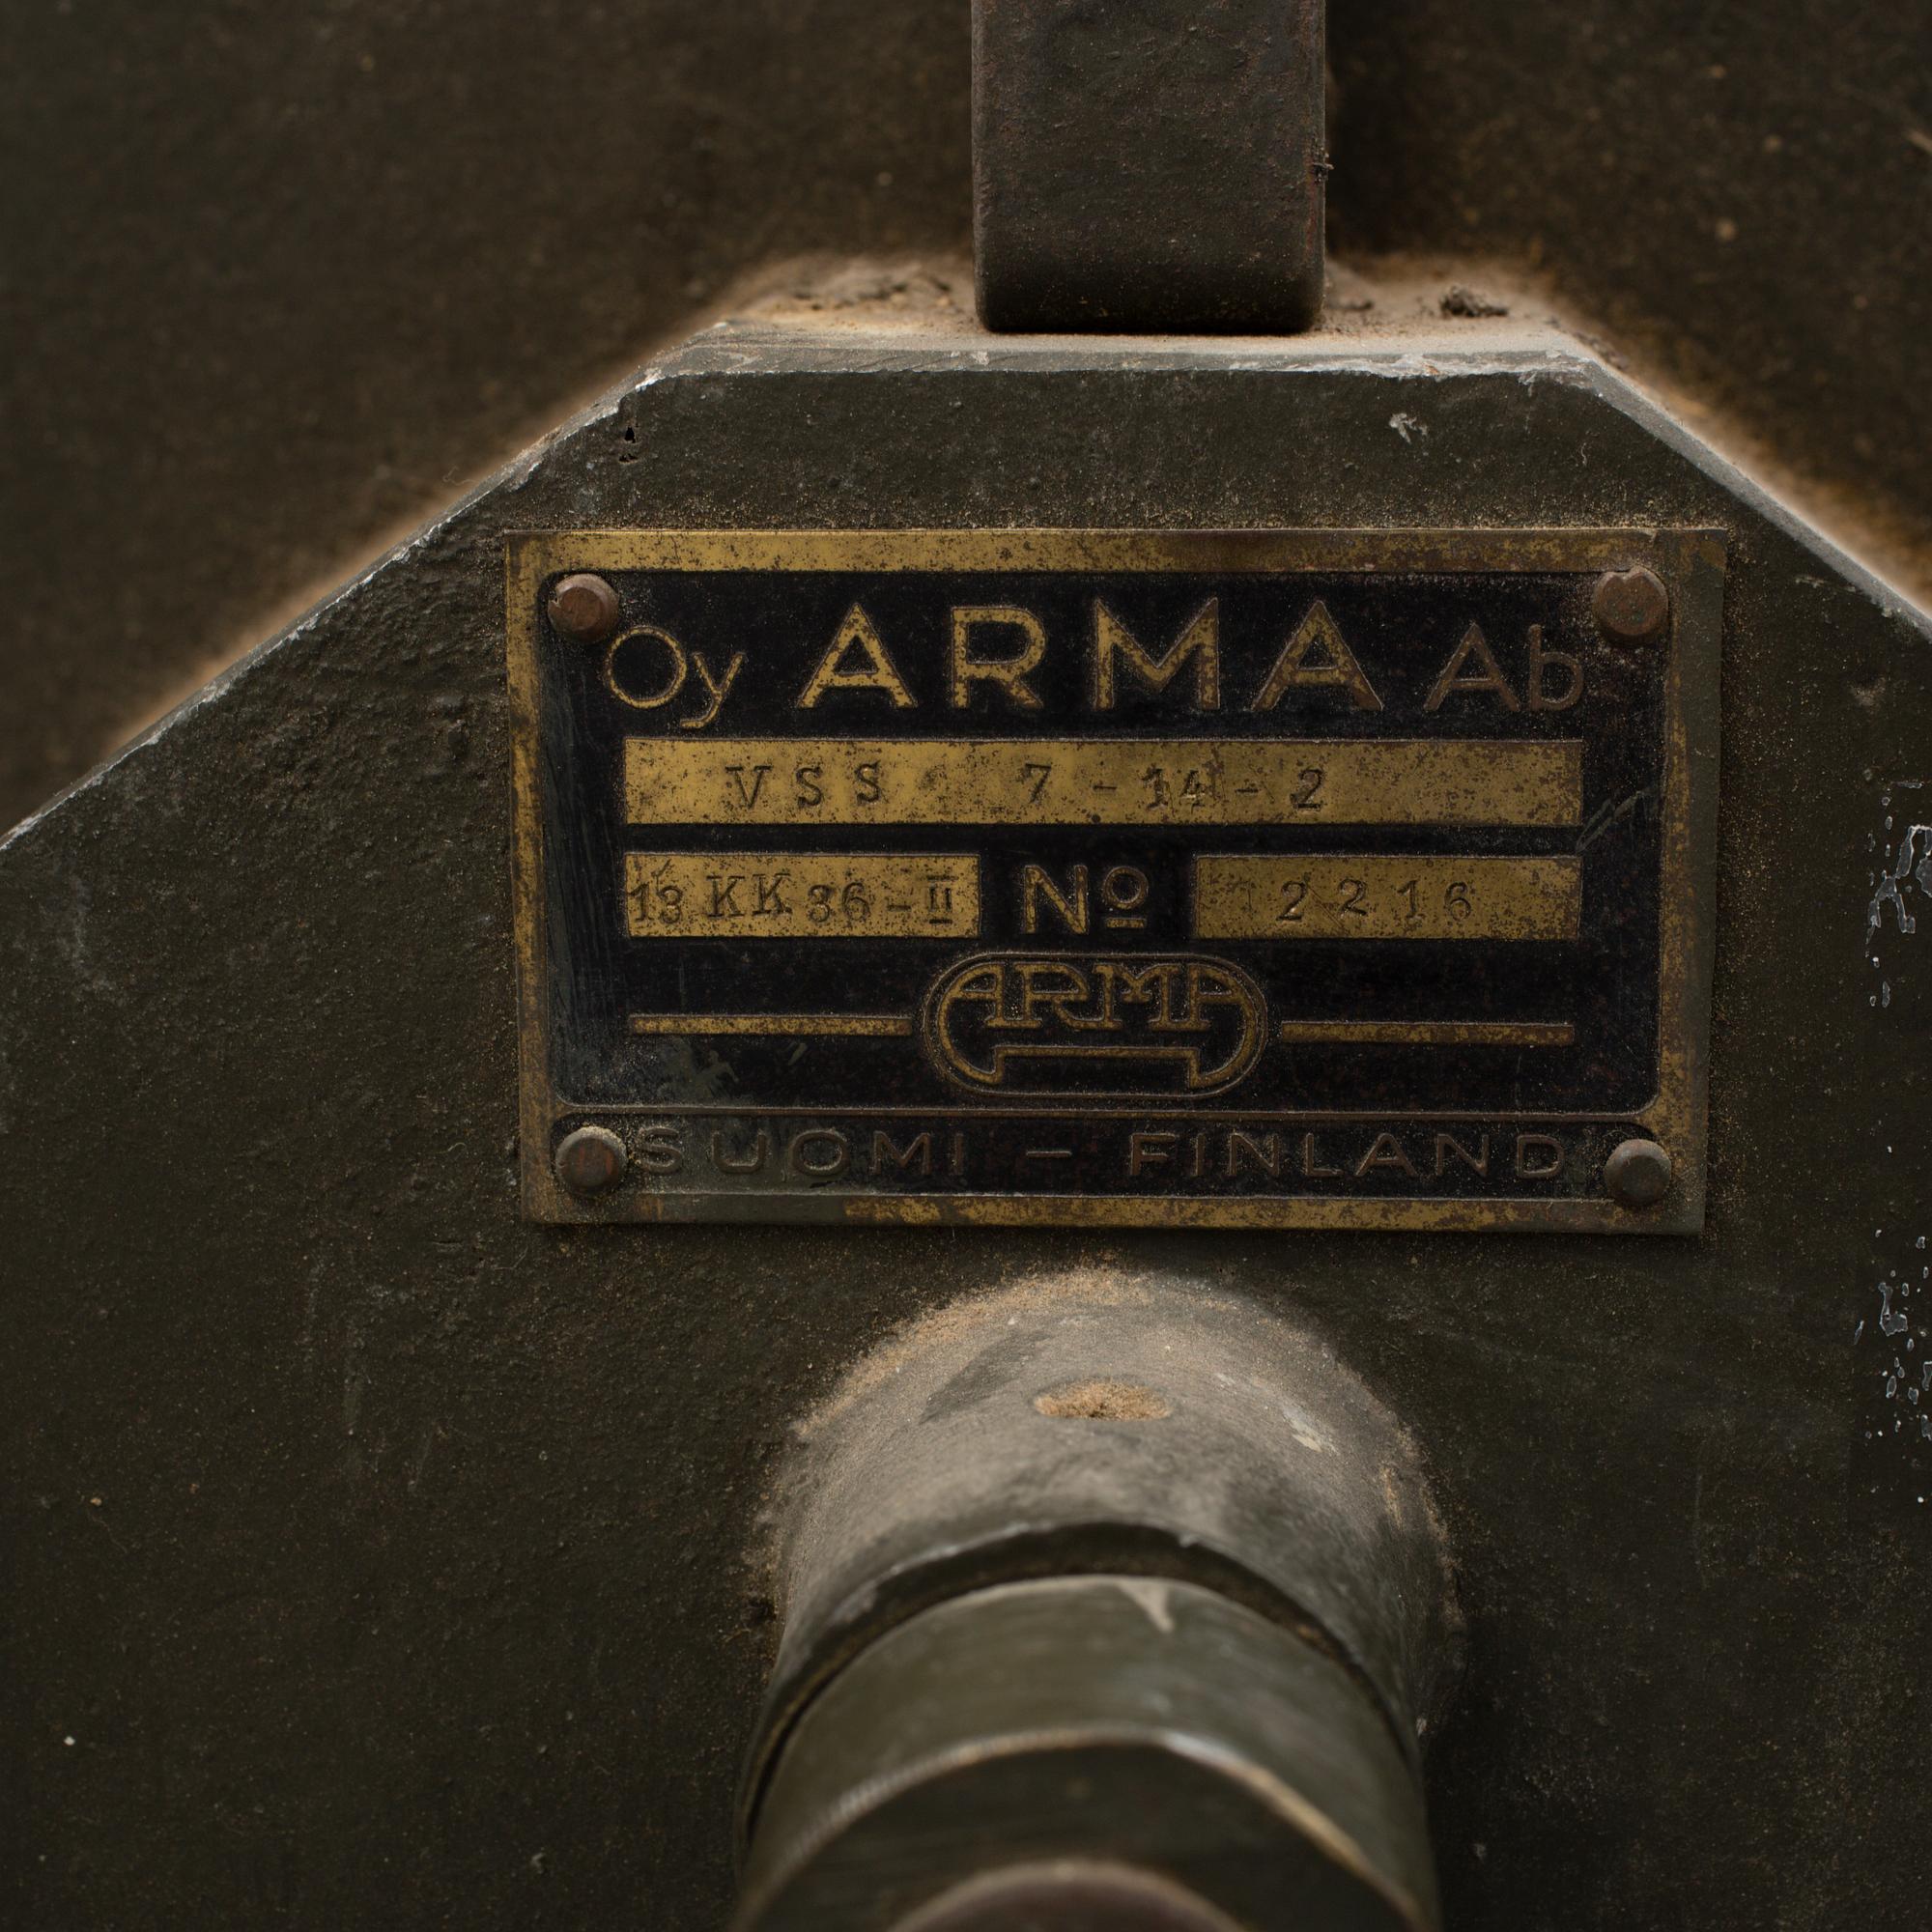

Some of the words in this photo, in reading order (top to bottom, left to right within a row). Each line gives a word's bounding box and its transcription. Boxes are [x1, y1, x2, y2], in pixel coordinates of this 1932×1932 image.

[605, 624, 746, 729] Oy
[796, 596, 1384, 710] ARMA
[1422, 621, 1585, 711] Ab
[725, 762, 881, 810] VSS
[1276, 879, 1473, 923] 2216
[937, 961, 1262, 1088] ARMA
[633, 1125, 966, 1177] SUOMI
[1128, 1131, 1567, 1180] FINLAND
